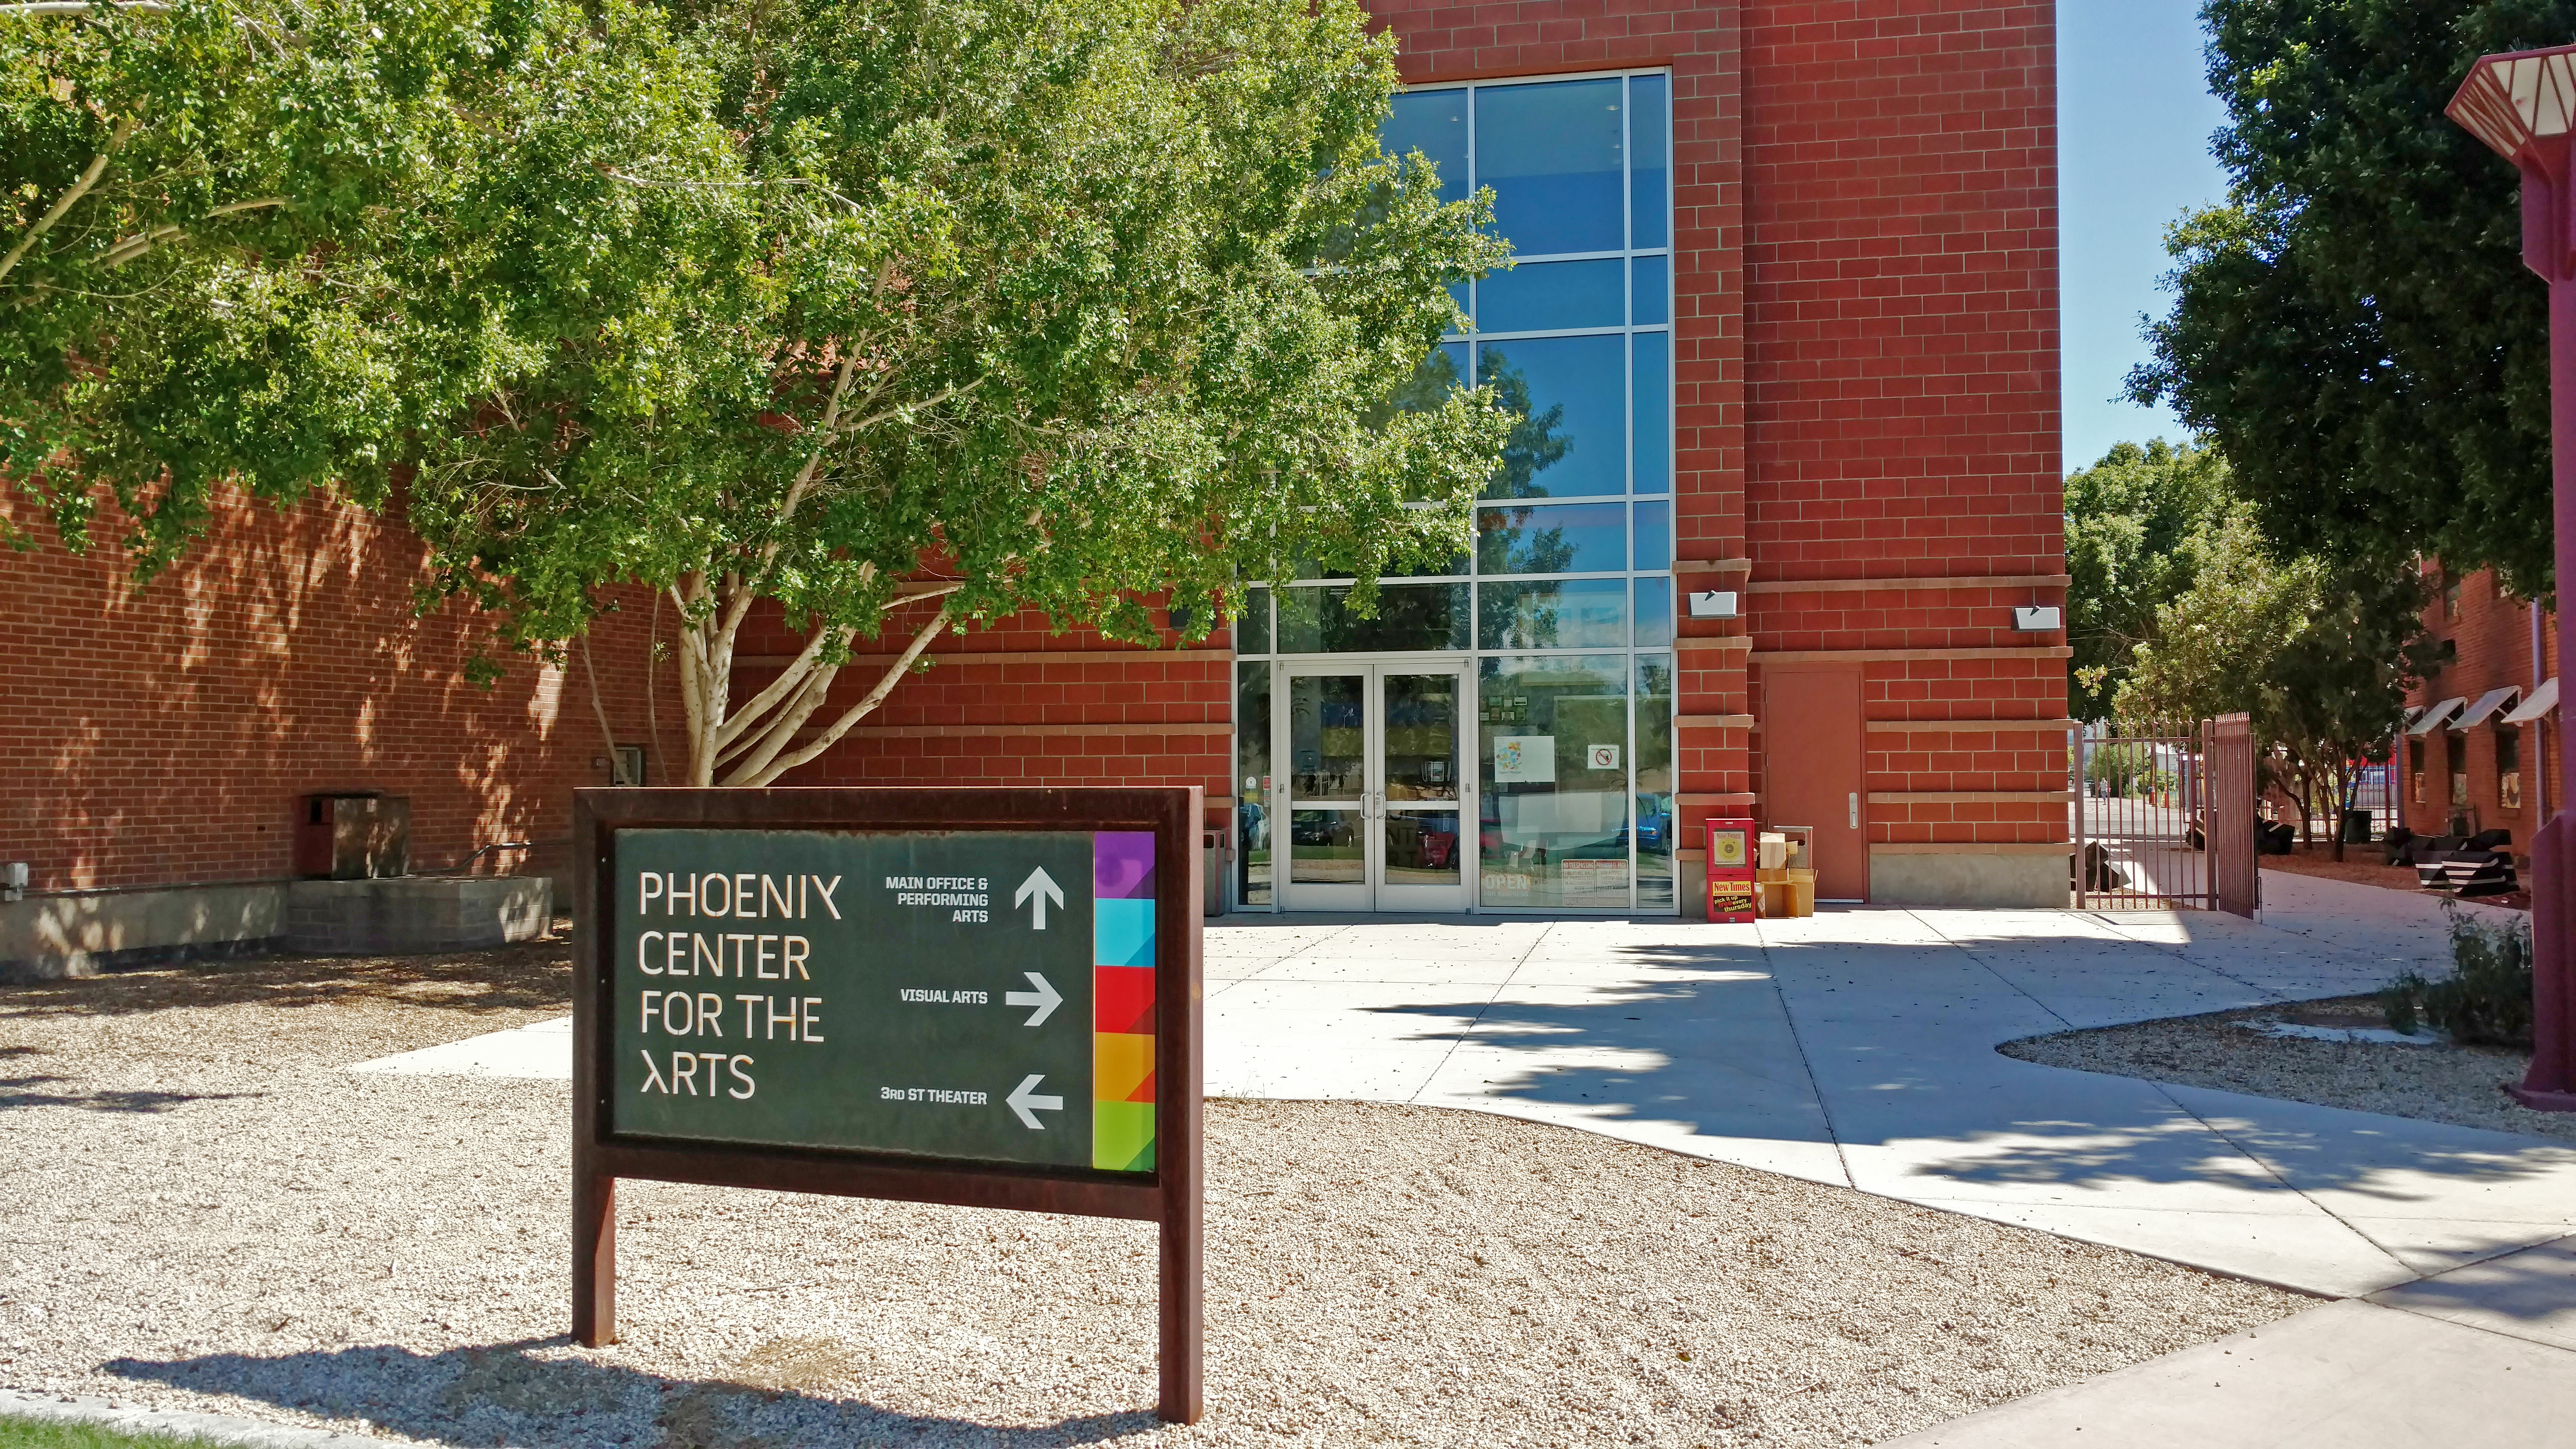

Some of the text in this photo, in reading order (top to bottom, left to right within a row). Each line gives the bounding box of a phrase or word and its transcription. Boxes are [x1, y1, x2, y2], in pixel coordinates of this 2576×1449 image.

[886, 876, 988, 890] MAIN OFFICE &
[1485, 874, 1527, 889] OPEN
[1714, 882, 1749, 891] New Times
[897, 892, 988, 906] PERFORMING
[1724, 902, 1752, 912] thursday
[952, 910, 988, 923] ARTS
[638, 931, 810, 980] CENTER
[900, 989, 988, 1004] VISUAL ARTS
[641, 990, 824, 1042] FOR THE
[881, 1087, 987, 1105] 3RD ST THEATER
